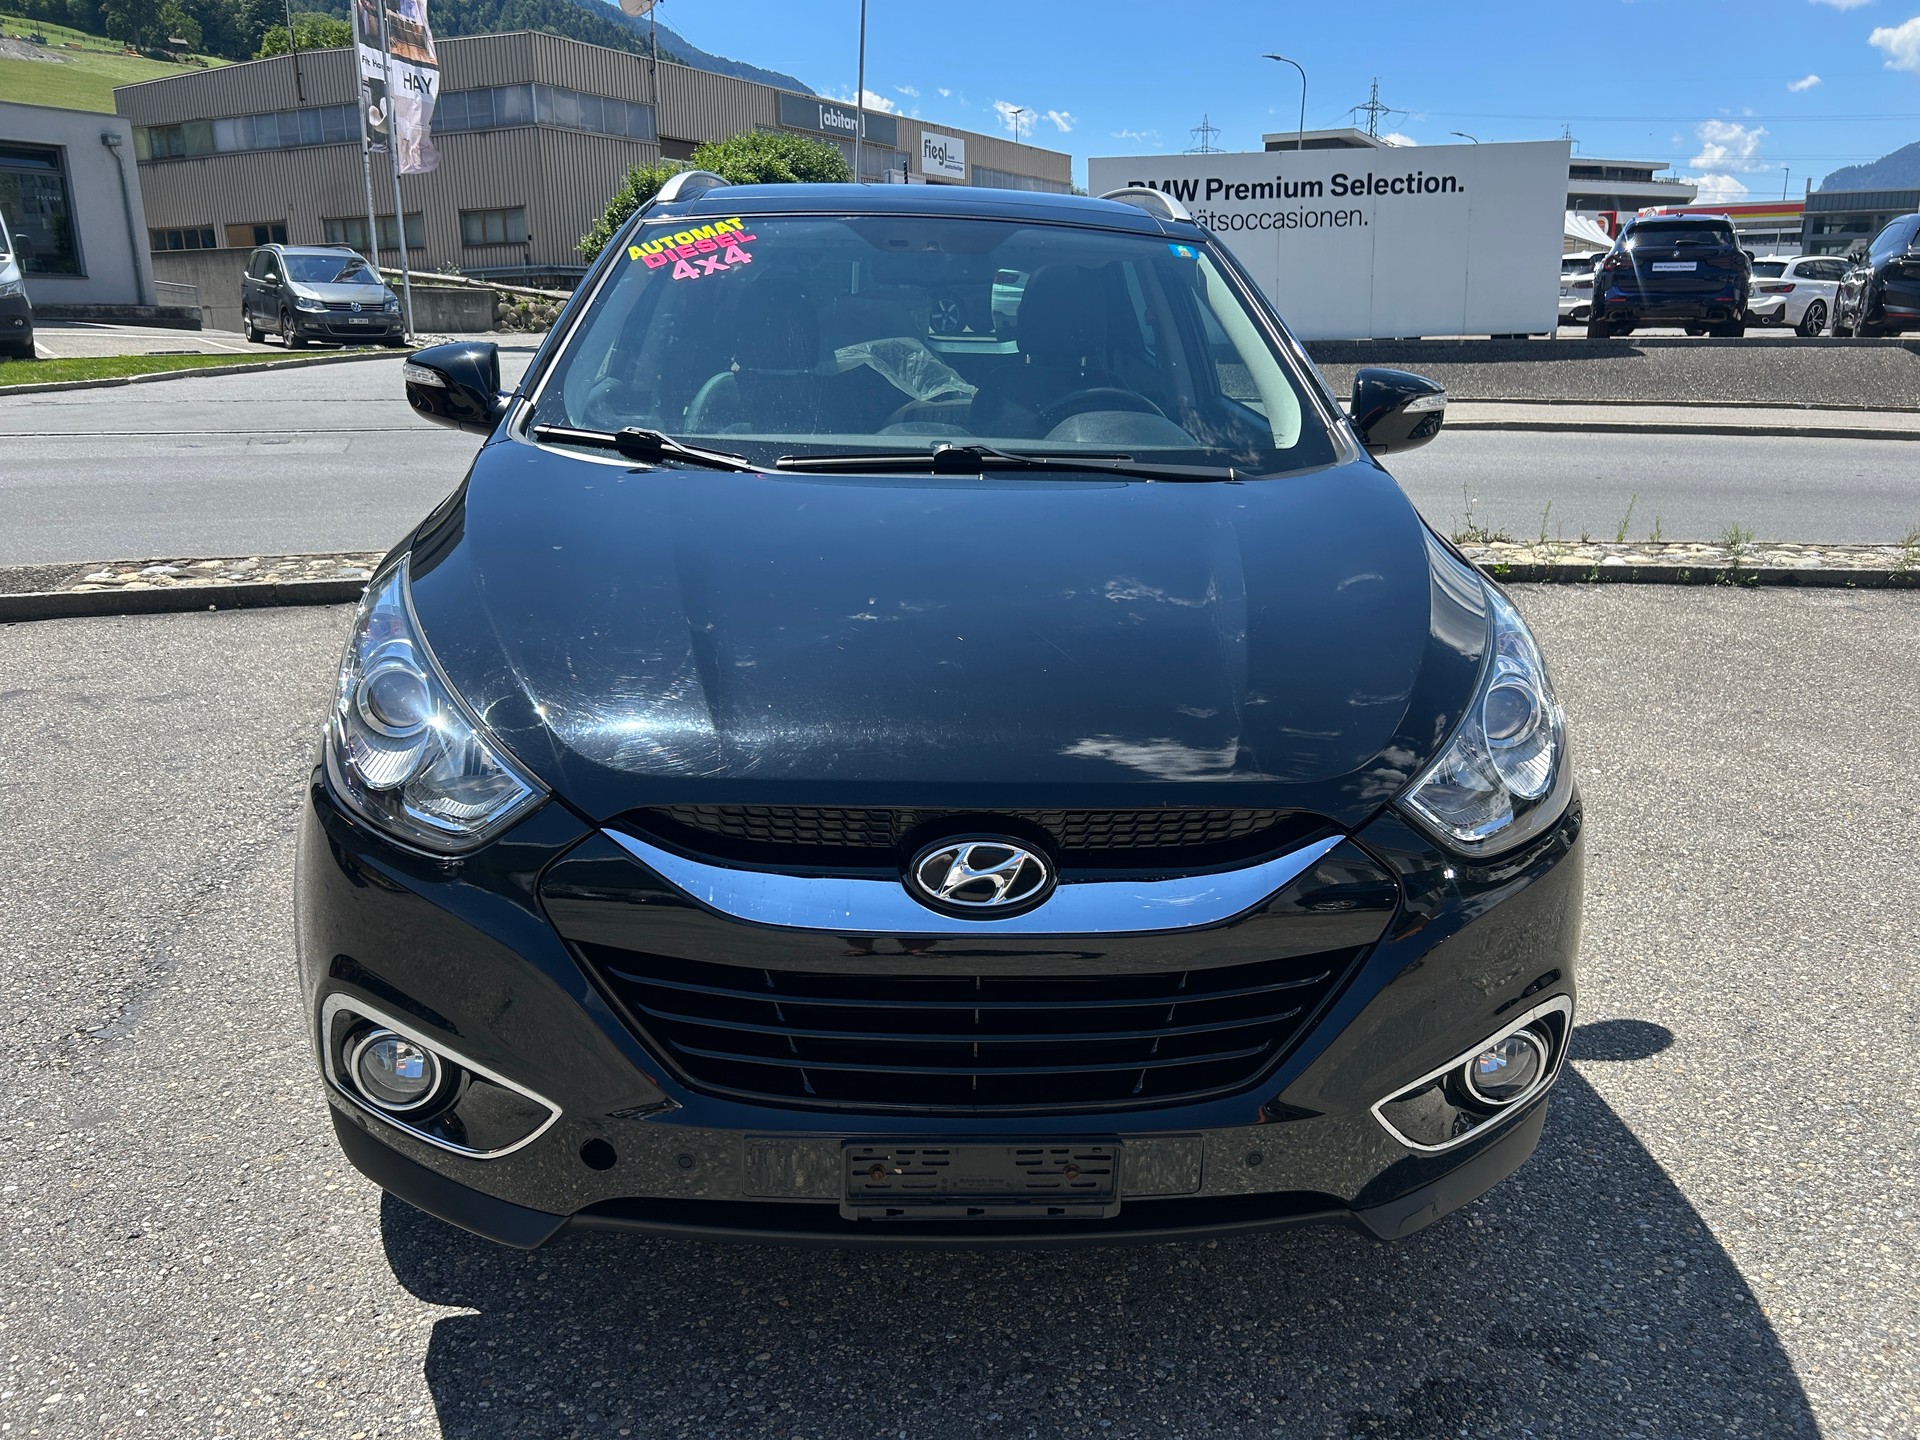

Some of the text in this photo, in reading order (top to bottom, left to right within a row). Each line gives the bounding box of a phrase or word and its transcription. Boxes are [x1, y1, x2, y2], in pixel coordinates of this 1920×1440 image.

[403, 71, 432, 94] HAY
[922, 138, 947, 166] fiegl
[1205, 176, 1323, 201] Premium
[1330, 171, 1464, 197] Selection.
[1190, 205, 1368, 232] ätsoccasionen.
[627, 217, 744, 260] AUTOMAT
[641, 230, 756, 269] DIESEL
